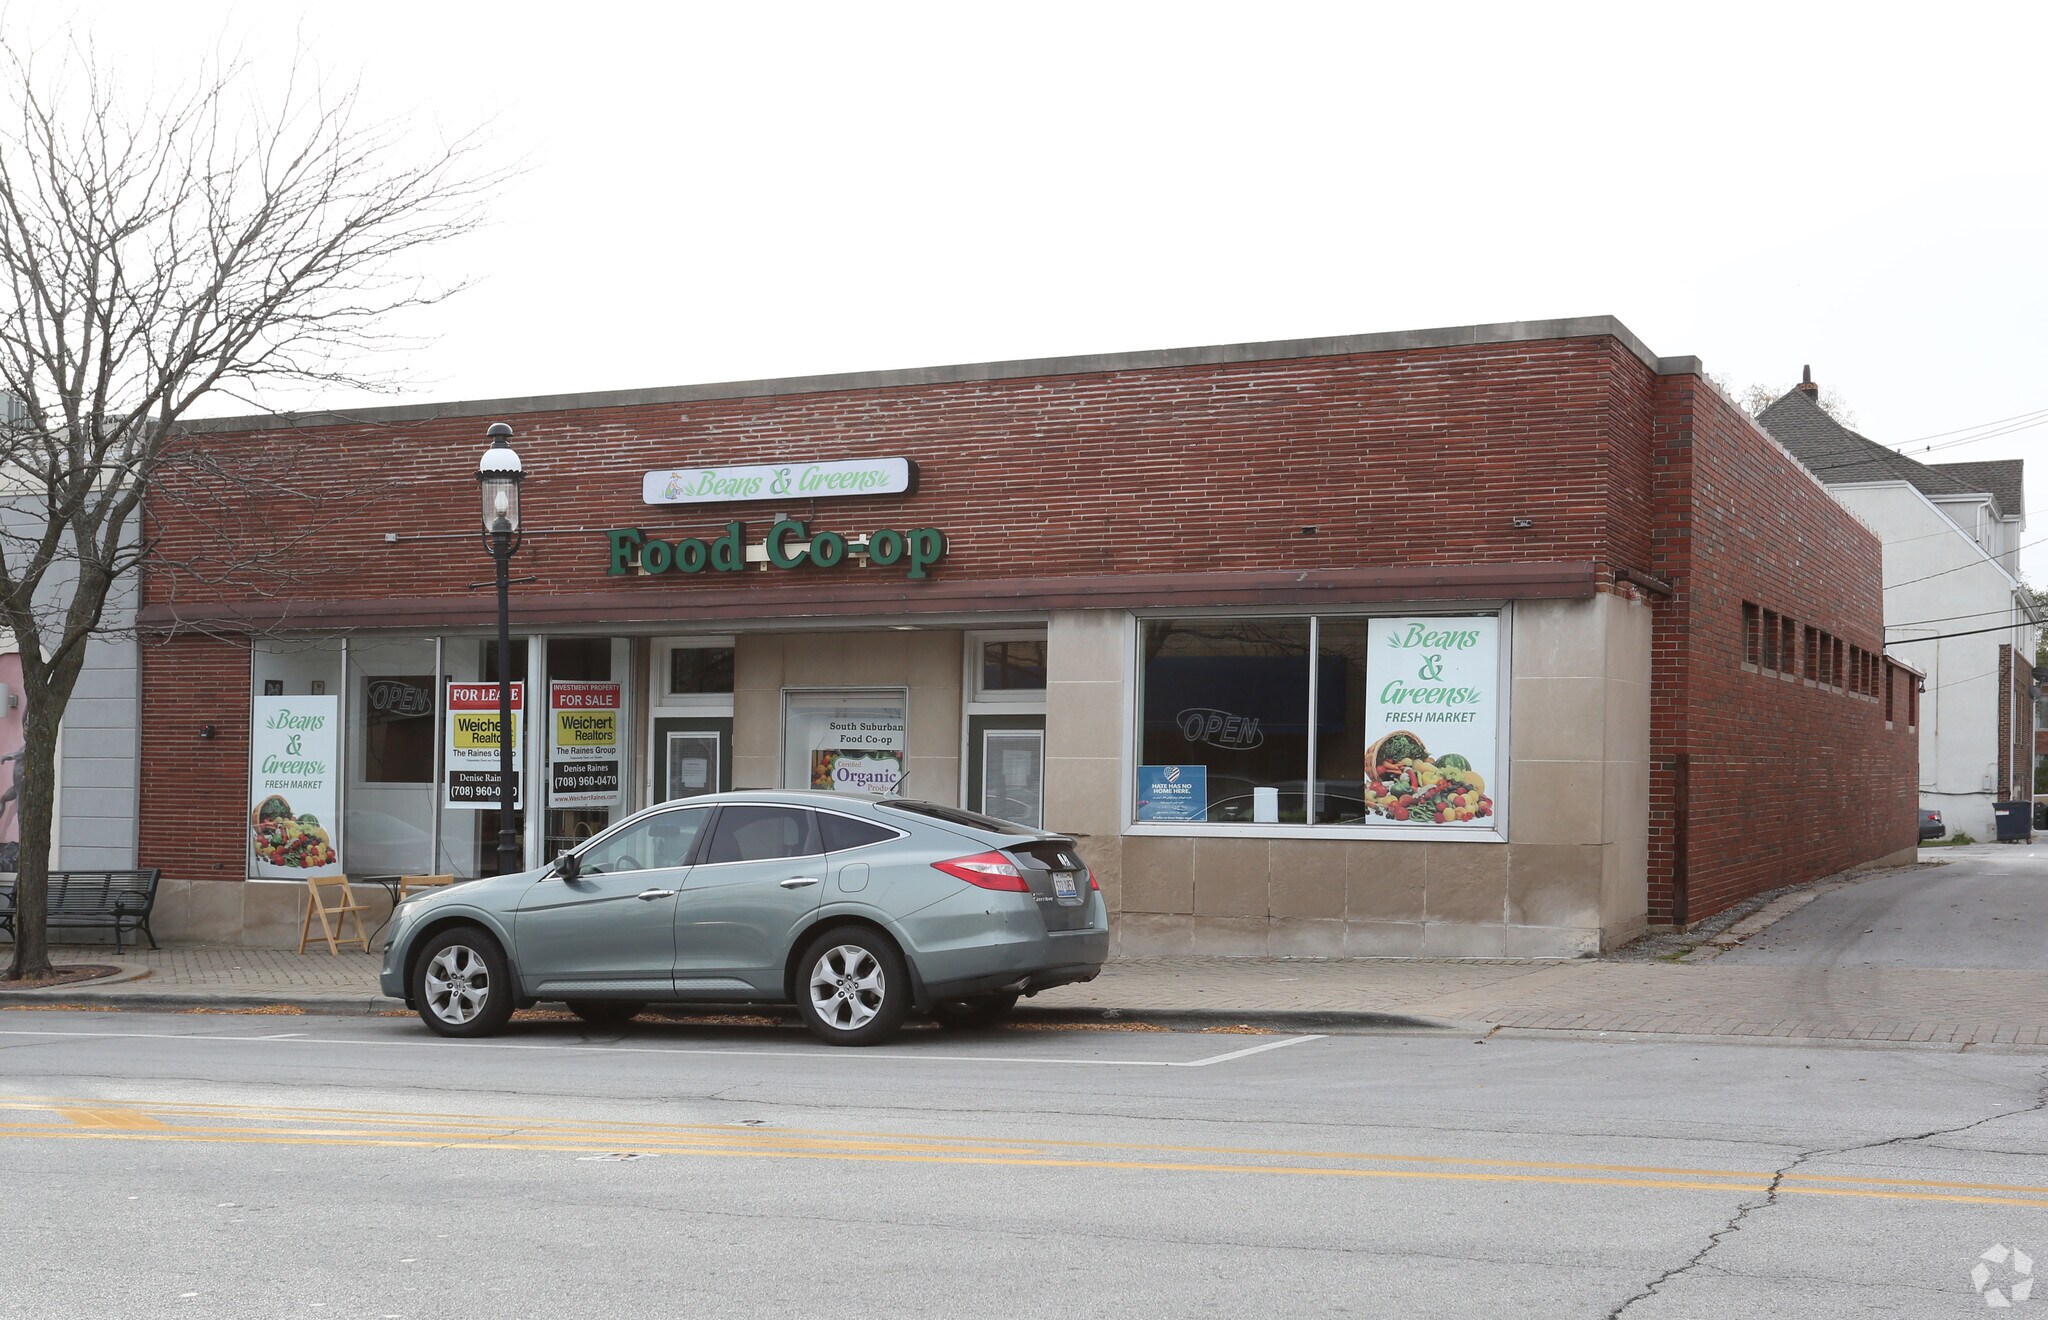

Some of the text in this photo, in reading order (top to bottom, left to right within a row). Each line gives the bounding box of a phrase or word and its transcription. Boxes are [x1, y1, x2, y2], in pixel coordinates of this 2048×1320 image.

[695, 465, 880, 498] Beans & Greens
[606, 519, 945, 579] Food Co-op
[1402, 622, 1481, 651] Beans
[1418, 653, 1444, 682] &
[372, 685, 429, 711] OPEN
[452, 688, 519, 701] FOR LEE
[560, 694, 613, 706] FOR SALE
[1380, 679, 1469, 708] Greens
[275, 708, 326, 731] Beans
[561, 716, 613, 730] Weichert
[1385, 711, 1477, 723] FRESH MARKET
[458, 718, 513, 732] Weiche
[829, 721, 904, 732] South Suburban
[1183, 713, 1260, 744] OPEN
[472, 732, 513, 744] Realto
[575, 730, 613, 741] Realtors
[840, 734, 893, 746] Food Co-op
[286, 733, 302, 757] &
[556, 746, 617, 755] The Raines Group
[452, 749, 466, 757] The
[467, 749, 492, 757] Raines
[261, 754, 318, 776] Greens
[563, 764, 609, 773] Denise Raines
[460, 773, 502, 782] Denise Rain
[554, 775, 617, 789] (708) 960-0470
[836, 767, 897, 787] Organic
[265, 780, 323, 789] FRESH MARKET
[451, 786, 518, 798] (708) 960-00
[554, 794, 618, 802] www.WeichertRaines.com
